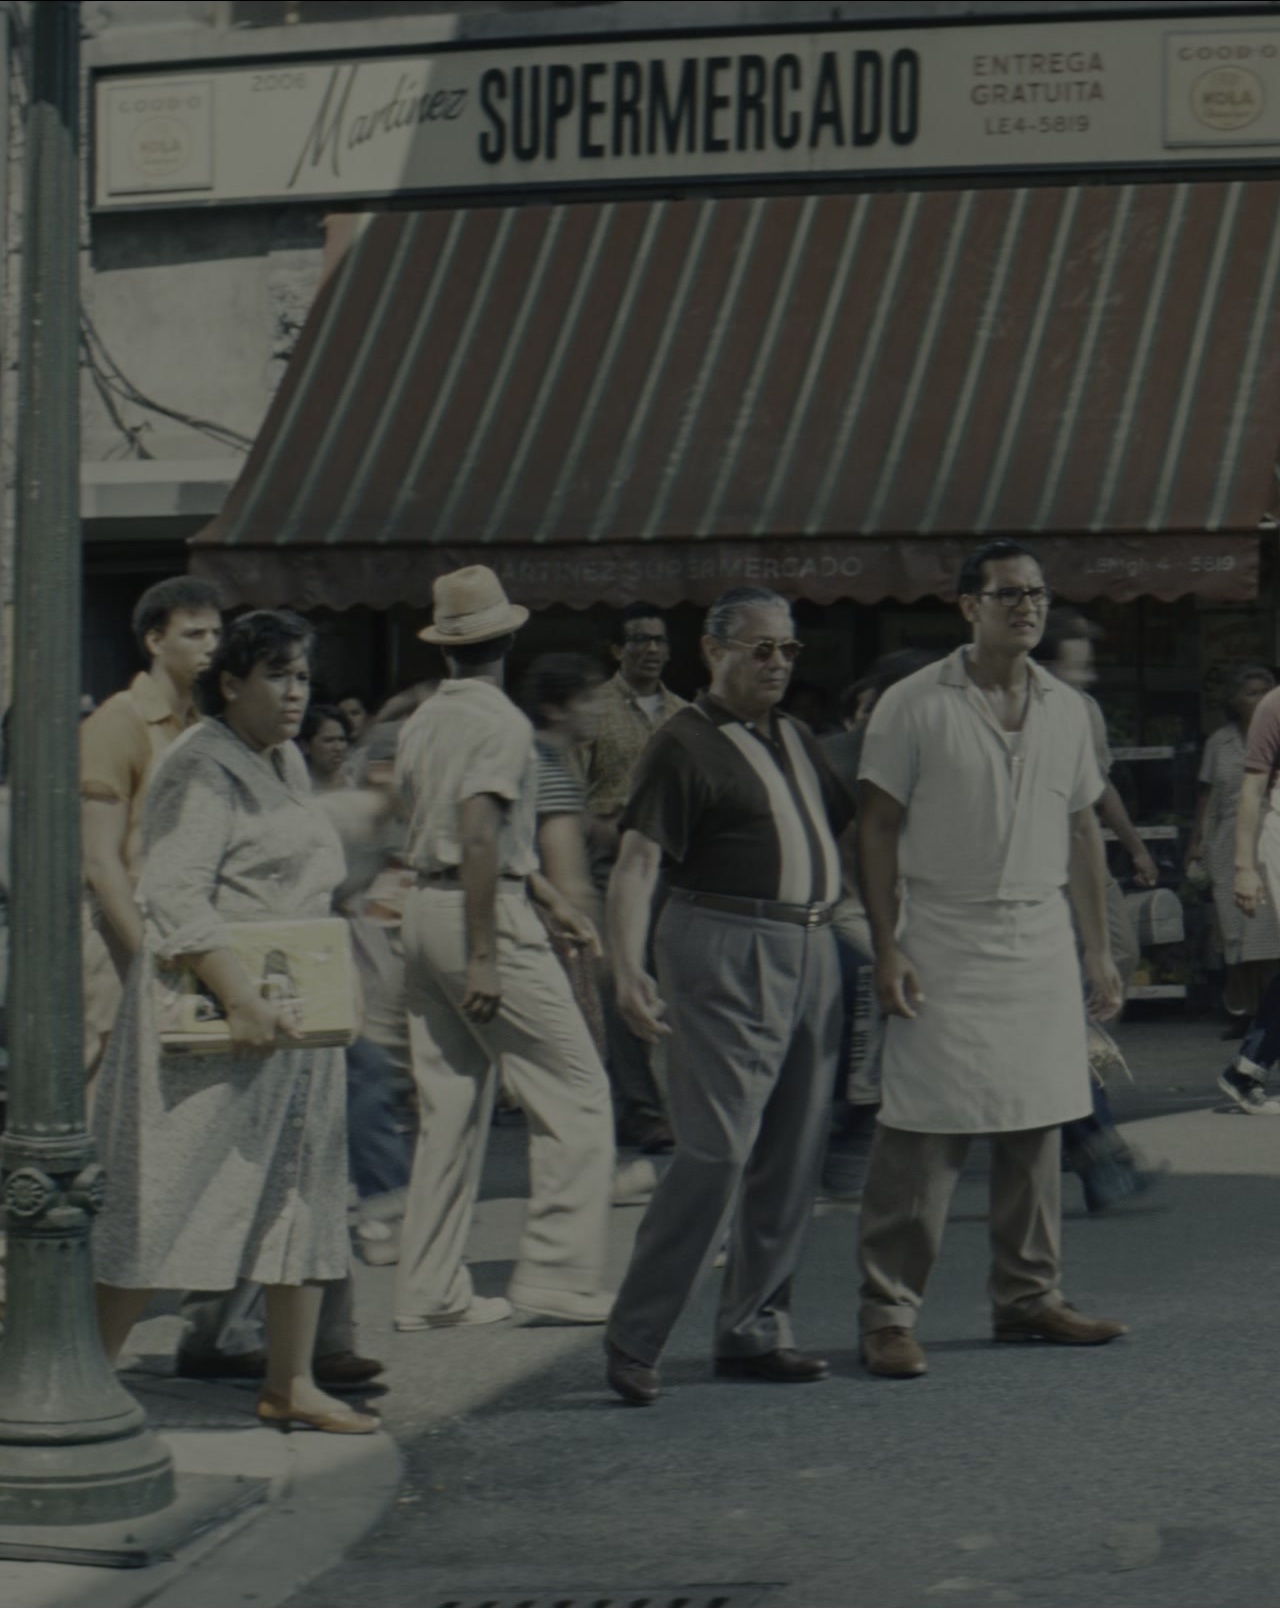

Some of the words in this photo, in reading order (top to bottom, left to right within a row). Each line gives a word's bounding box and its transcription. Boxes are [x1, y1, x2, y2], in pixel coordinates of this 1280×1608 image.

[972, 51, 1105, 76] ENTREGA
[970, 81, 1105, 105] GRATUITA
[286, 64, 469, 188] Martinez
[480, 48, 920, 166] SUPERMERCADO
[984, 114, 1090, 135] LE4-5819
[497, 560, 616, 582] ARTINEZ
[618, 556, 863, 582] SUPERMERCADO
